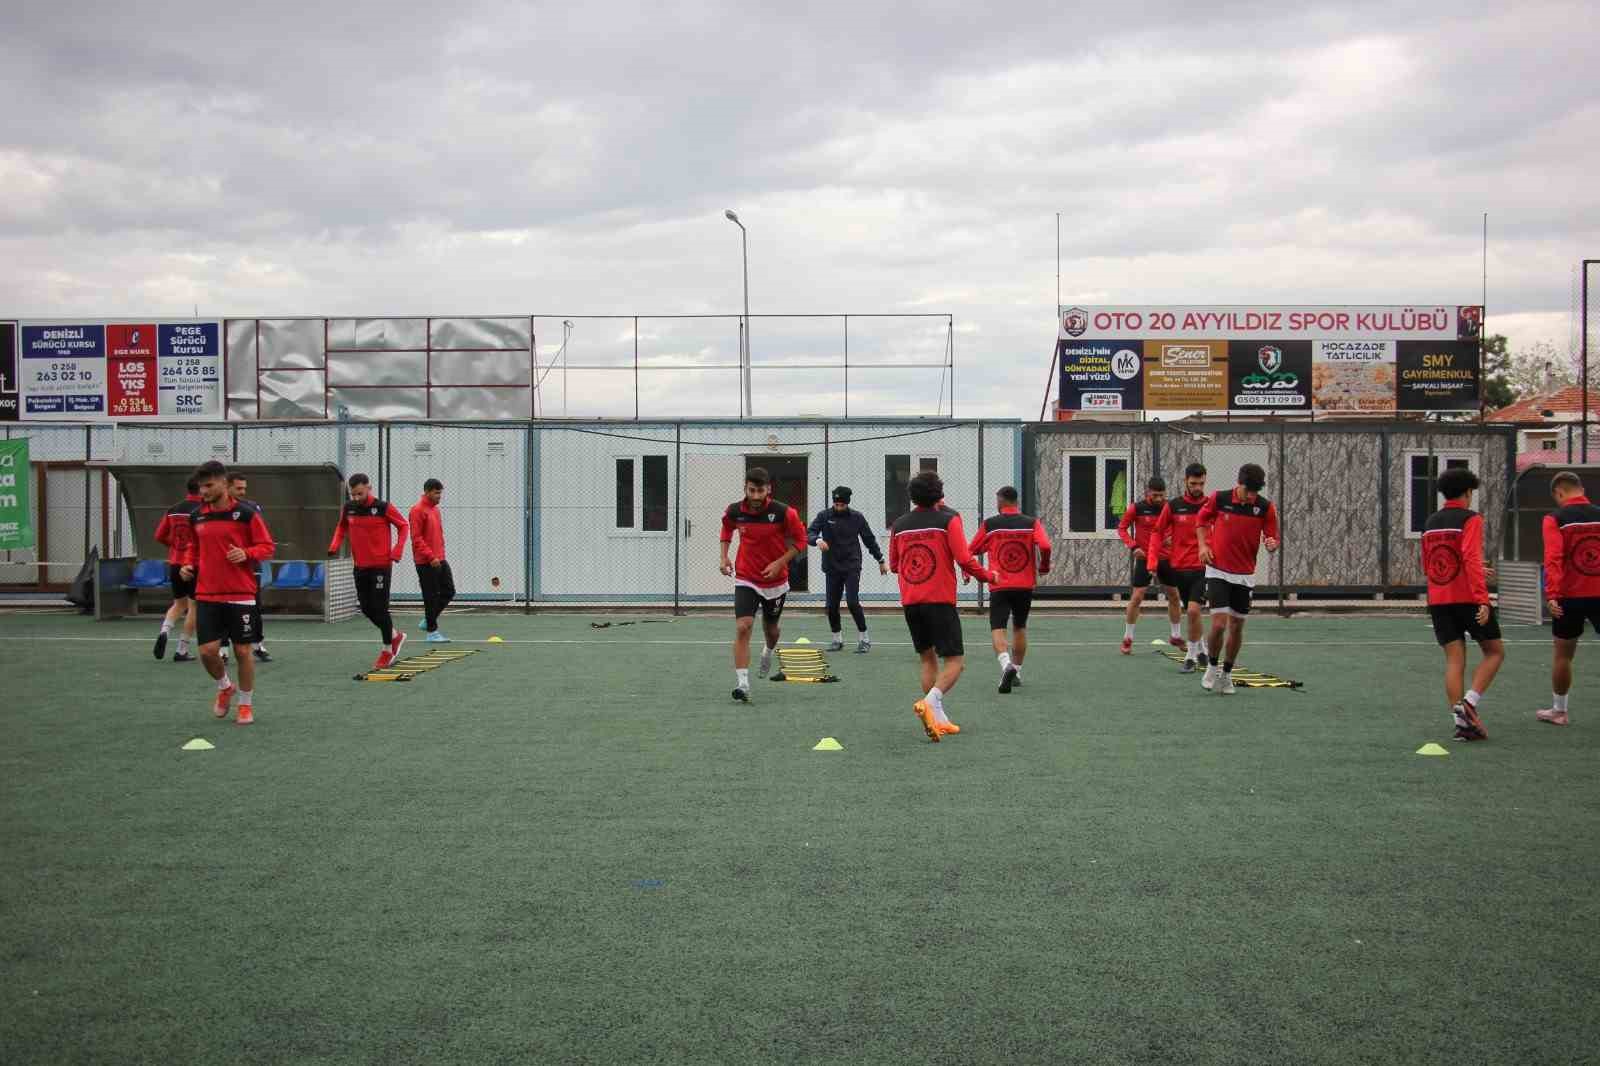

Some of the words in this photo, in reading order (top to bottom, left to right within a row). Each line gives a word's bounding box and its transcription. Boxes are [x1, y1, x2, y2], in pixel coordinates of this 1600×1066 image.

[1094, 312, 1142, 330] OTO
[1149, 312, 1176, 330] 20
[1181, 312, 1282, 330] AYYILDIZ
[1289, 312, 1350, 330] SPOR
[1356, 308, 1448, 331] KULÜBÜ
[43, 327, 84, 340] DENİZLİ
[169, 336, 207, 346] Sürücü
[1322, 342, 1386, 351] HOCAZADE
[173, 345, 204, 355] Kursu
[1327, 352, 1382, 360] TATLICILIK
[1423, 354, 1454, 367] SMY
[119, 362, 145, 373] LGS
[161, 367, 183, 376] 264
[186, 366, 200, 376] 65
[202, 366, 216, 376] 85
[37, 371, 58, 381] 263
[61, 371, 76, 381] 02
[79, 371, 92, 381] 10
[1402, 368, 1474, 379] GAYRİMENKUL
[120, 379, 145, 390] YKS
[176, 395, 203, 406] SRC
